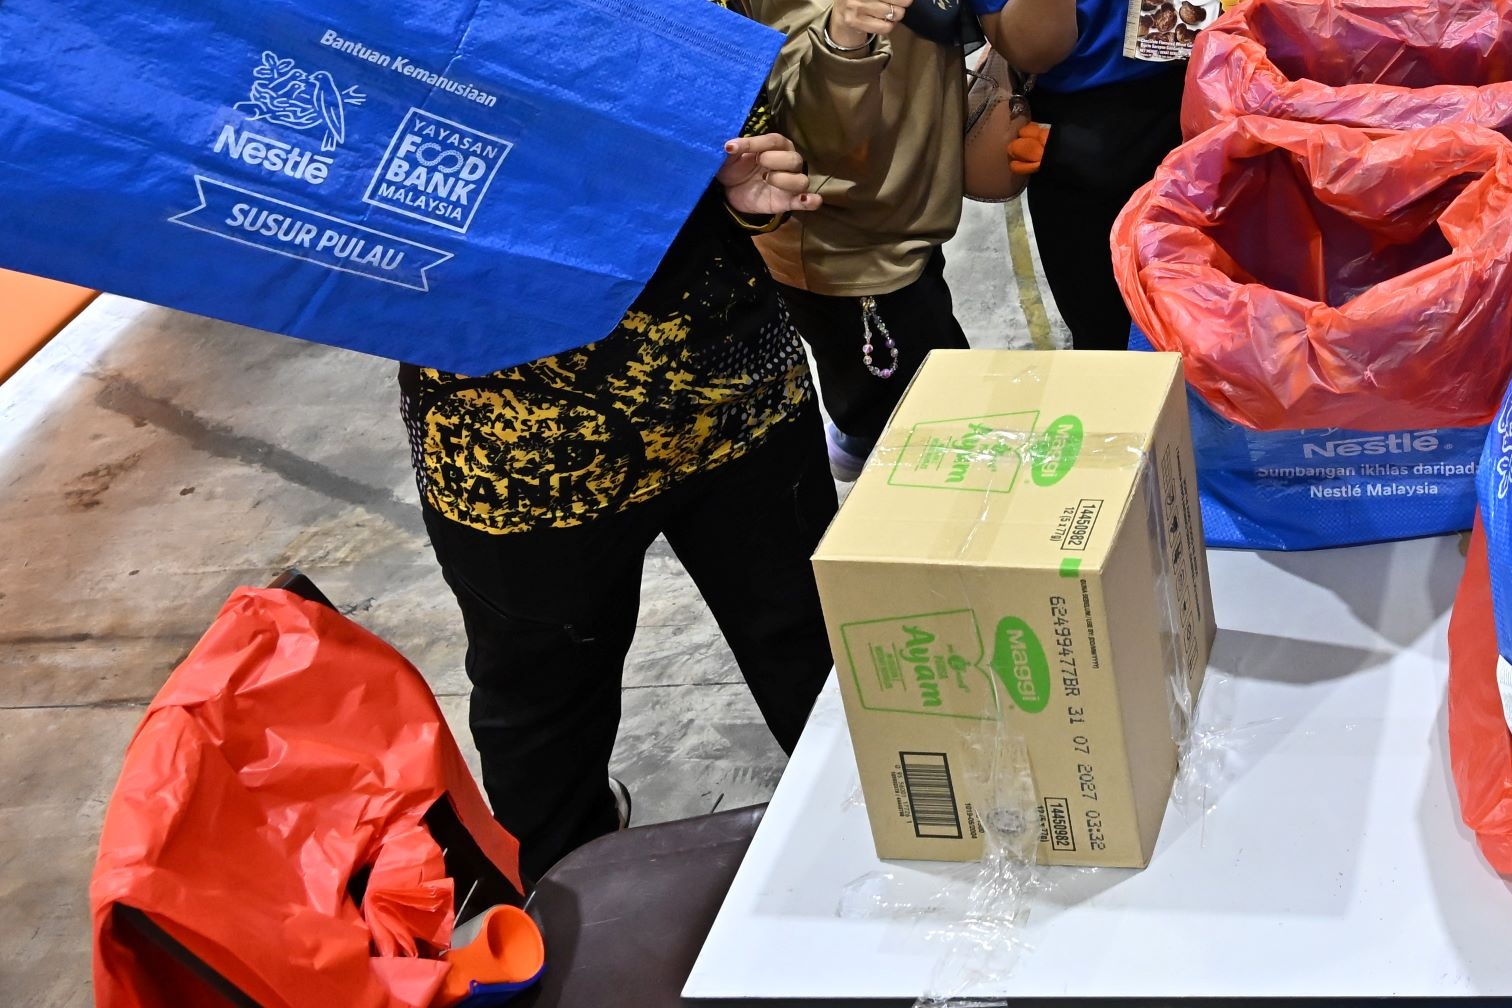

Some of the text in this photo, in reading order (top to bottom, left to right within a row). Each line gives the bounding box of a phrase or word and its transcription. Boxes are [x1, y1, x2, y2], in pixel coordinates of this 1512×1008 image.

[320, 29, 497, 108] Bantuan Kemanusiaan
[396, 134, 486, 181] FOOD
[413, 118, 499, 159] YAYASAN
[378, 183, 463, 221] MALAYSIA
[385, 160, 476, 205] BANK
[225, 203, 405, 271] SUSUR PULAU
[1257, 465, 1356, 479] Sumbangan
[1361, 463, 1408, 476] ikhlas
[1310, 482, 1438, 498] Nestlé Malaysia
[1064, 506, 1074, 515] 12
[1067, 503, 1097, 547] 14450982
[1050, 527, 1066, 542] 77g)
[900, 625, 943, 707] Ayam
[1006, 629, 1040, 702] Maggi
[1050, 596, 1105, 851] 62499477BR 31 07 2027 03:32
[1050, 803, 1071, 847] 14450982
